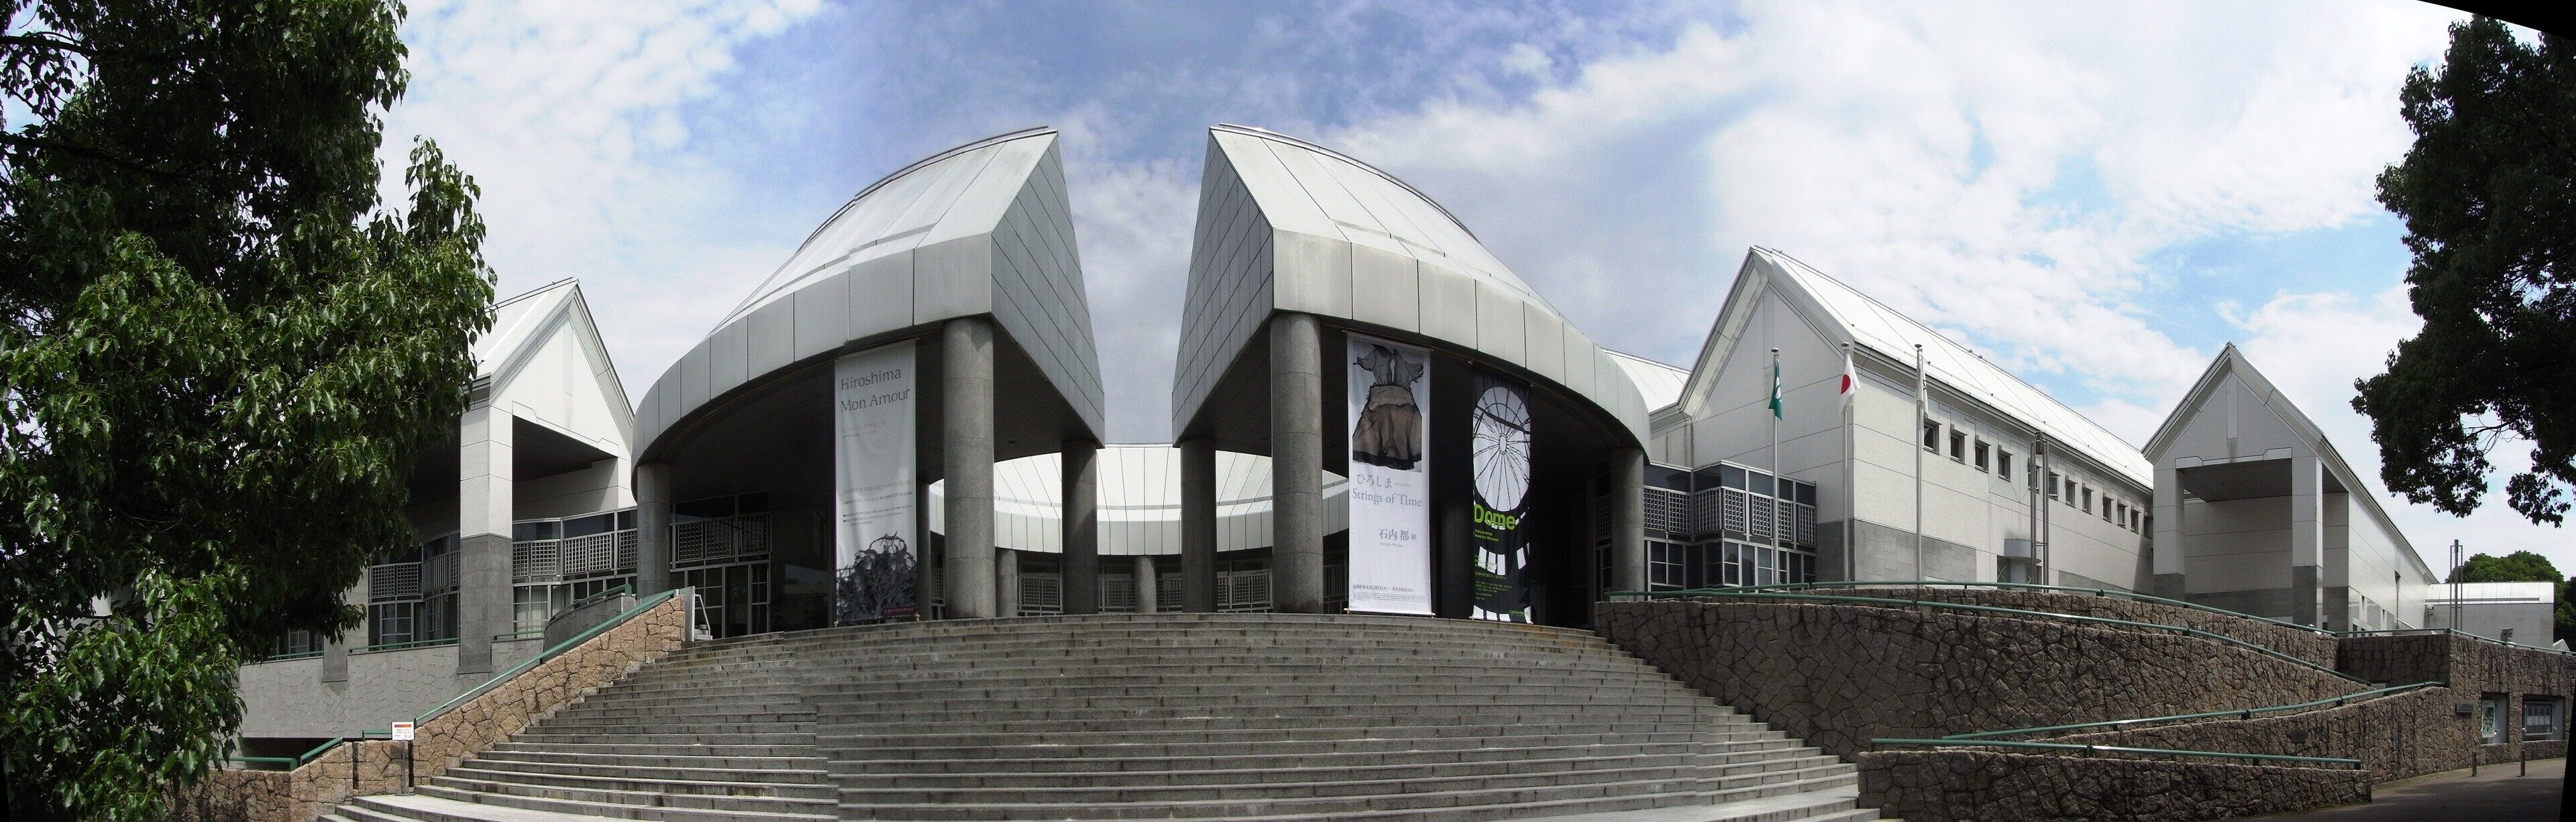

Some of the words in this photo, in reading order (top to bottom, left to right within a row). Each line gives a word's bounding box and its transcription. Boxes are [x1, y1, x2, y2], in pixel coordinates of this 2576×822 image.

[841, 369, 902, 390] Hiroshima
[841, 399, 866, 412] Mon
[870, 389, 910, 406] Amour
[1356, 473, 1392, 488] ひろしま
[1352, 488, 1383, 505] Strings
[1385, 493, 1396, 504] of
[1398, 493, 1422, 507] Time
[1474, 504, 1516, 530] Dome
